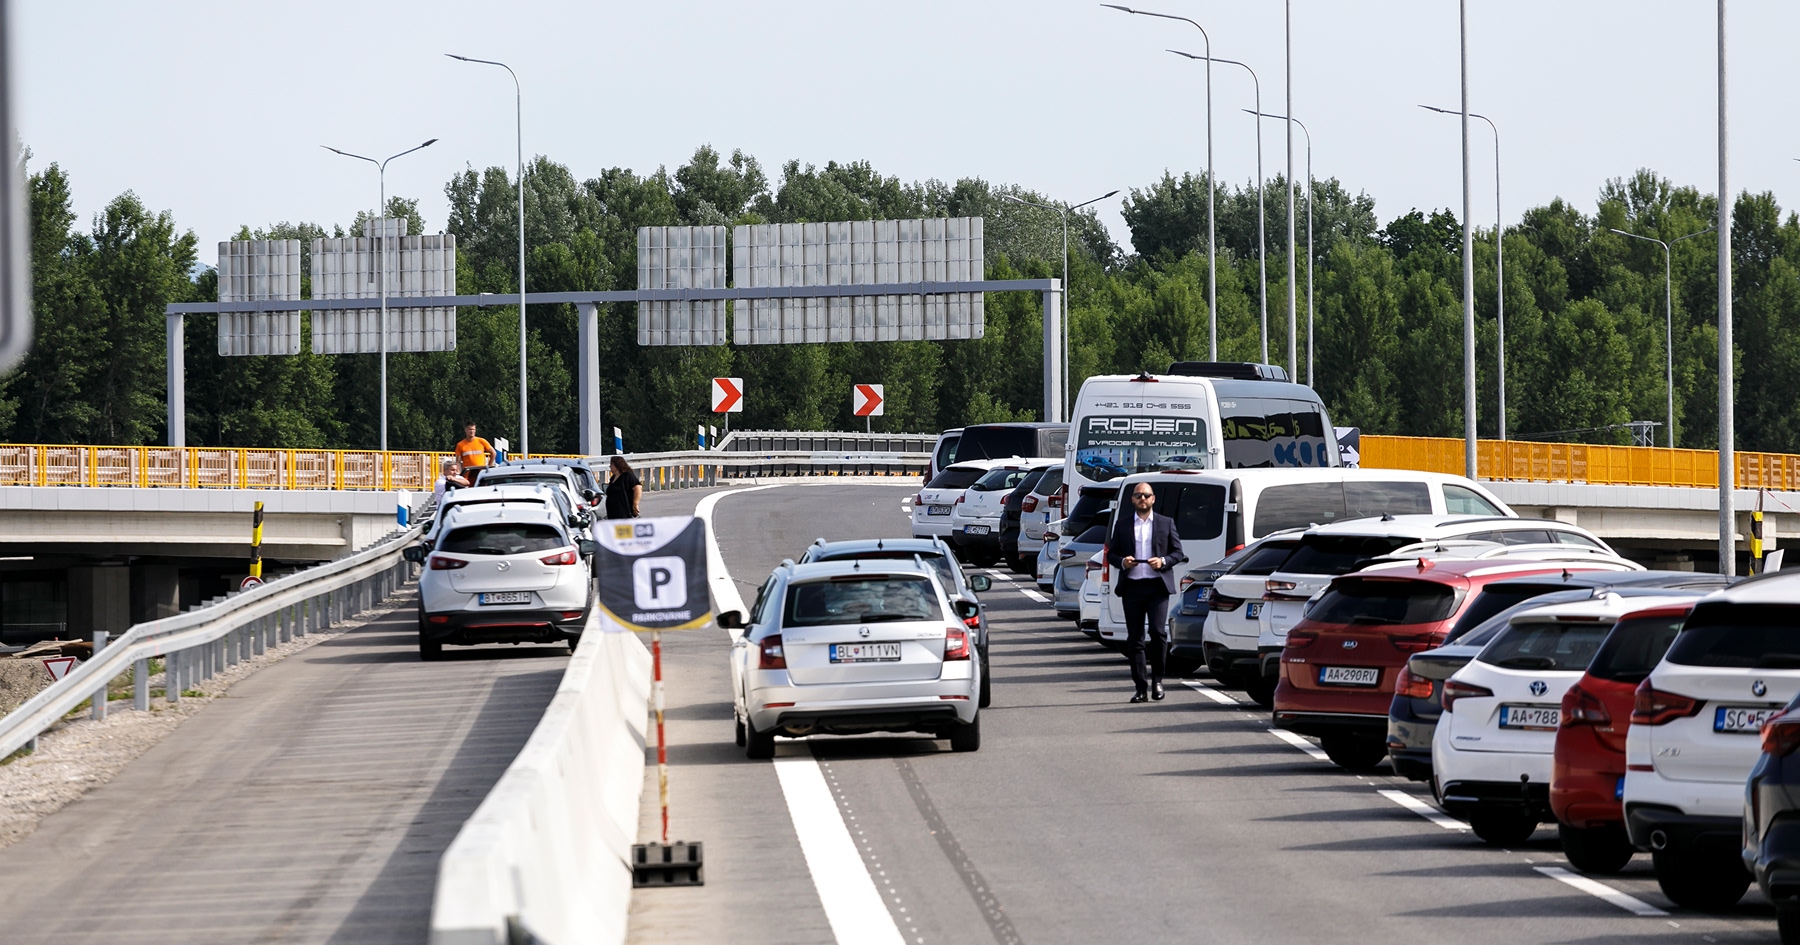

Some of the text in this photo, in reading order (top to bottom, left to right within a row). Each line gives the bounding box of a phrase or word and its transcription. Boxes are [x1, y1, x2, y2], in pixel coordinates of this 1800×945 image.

[1089, 418, 1198, 432] ROBEN
[650, 567, 671, 600] P
[632, 610, 692, 623] PARKOVANIE
